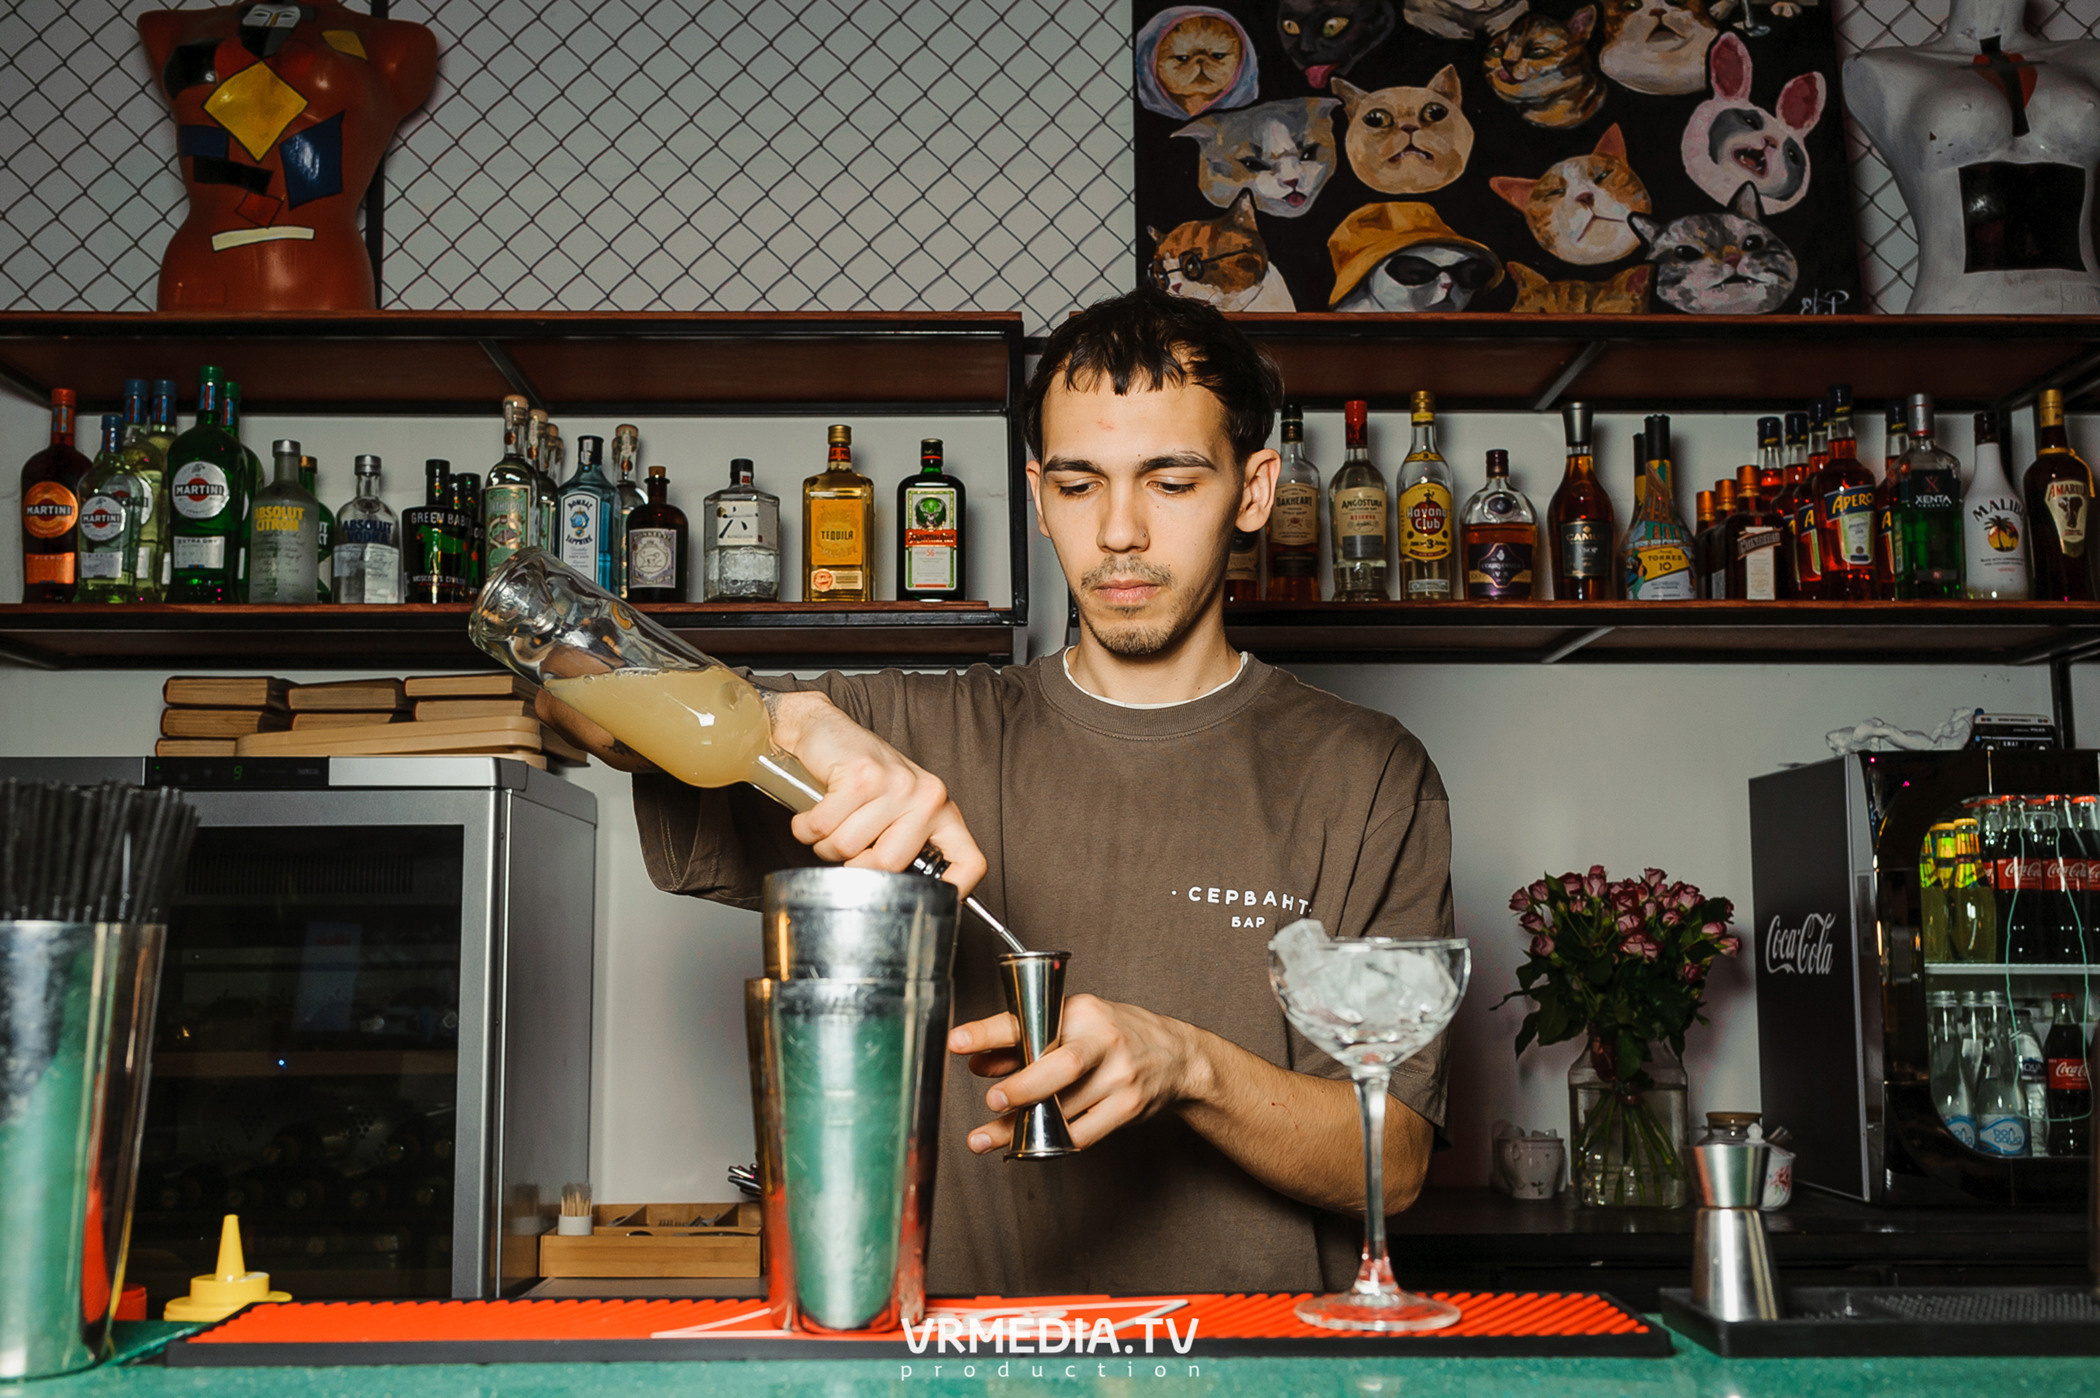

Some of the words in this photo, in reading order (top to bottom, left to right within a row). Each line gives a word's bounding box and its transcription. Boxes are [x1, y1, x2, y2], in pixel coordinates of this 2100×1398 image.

[175, 485, 223, 495] MARTINI
[1341, 498, 1383, 509] ANGOSTURA
[1914, 494, 1952, 505] XENTA
[26, 505, 72, 516] MARTINI
[254, 505, 305, 520] ABSOLUT
[1406, 505, 1448, 518] Havana
[83, 514, 120, 522] MARTINI
[411, 512, 445, 524] GREEN
[1415, 518, 1441, 529] Club
[256, 519, 300, 532] CITRON
[343, 520, 393, 533] ABSOLUT
[347, 531, 389, 544] VODKA
[821, 530, 854, 541] TEQUILA
[1660, 562, 1672, 571] 10
[1188, 886, 1309, 915] СЕРВАНТ
[1231, 916, 1266, 928] БАР
